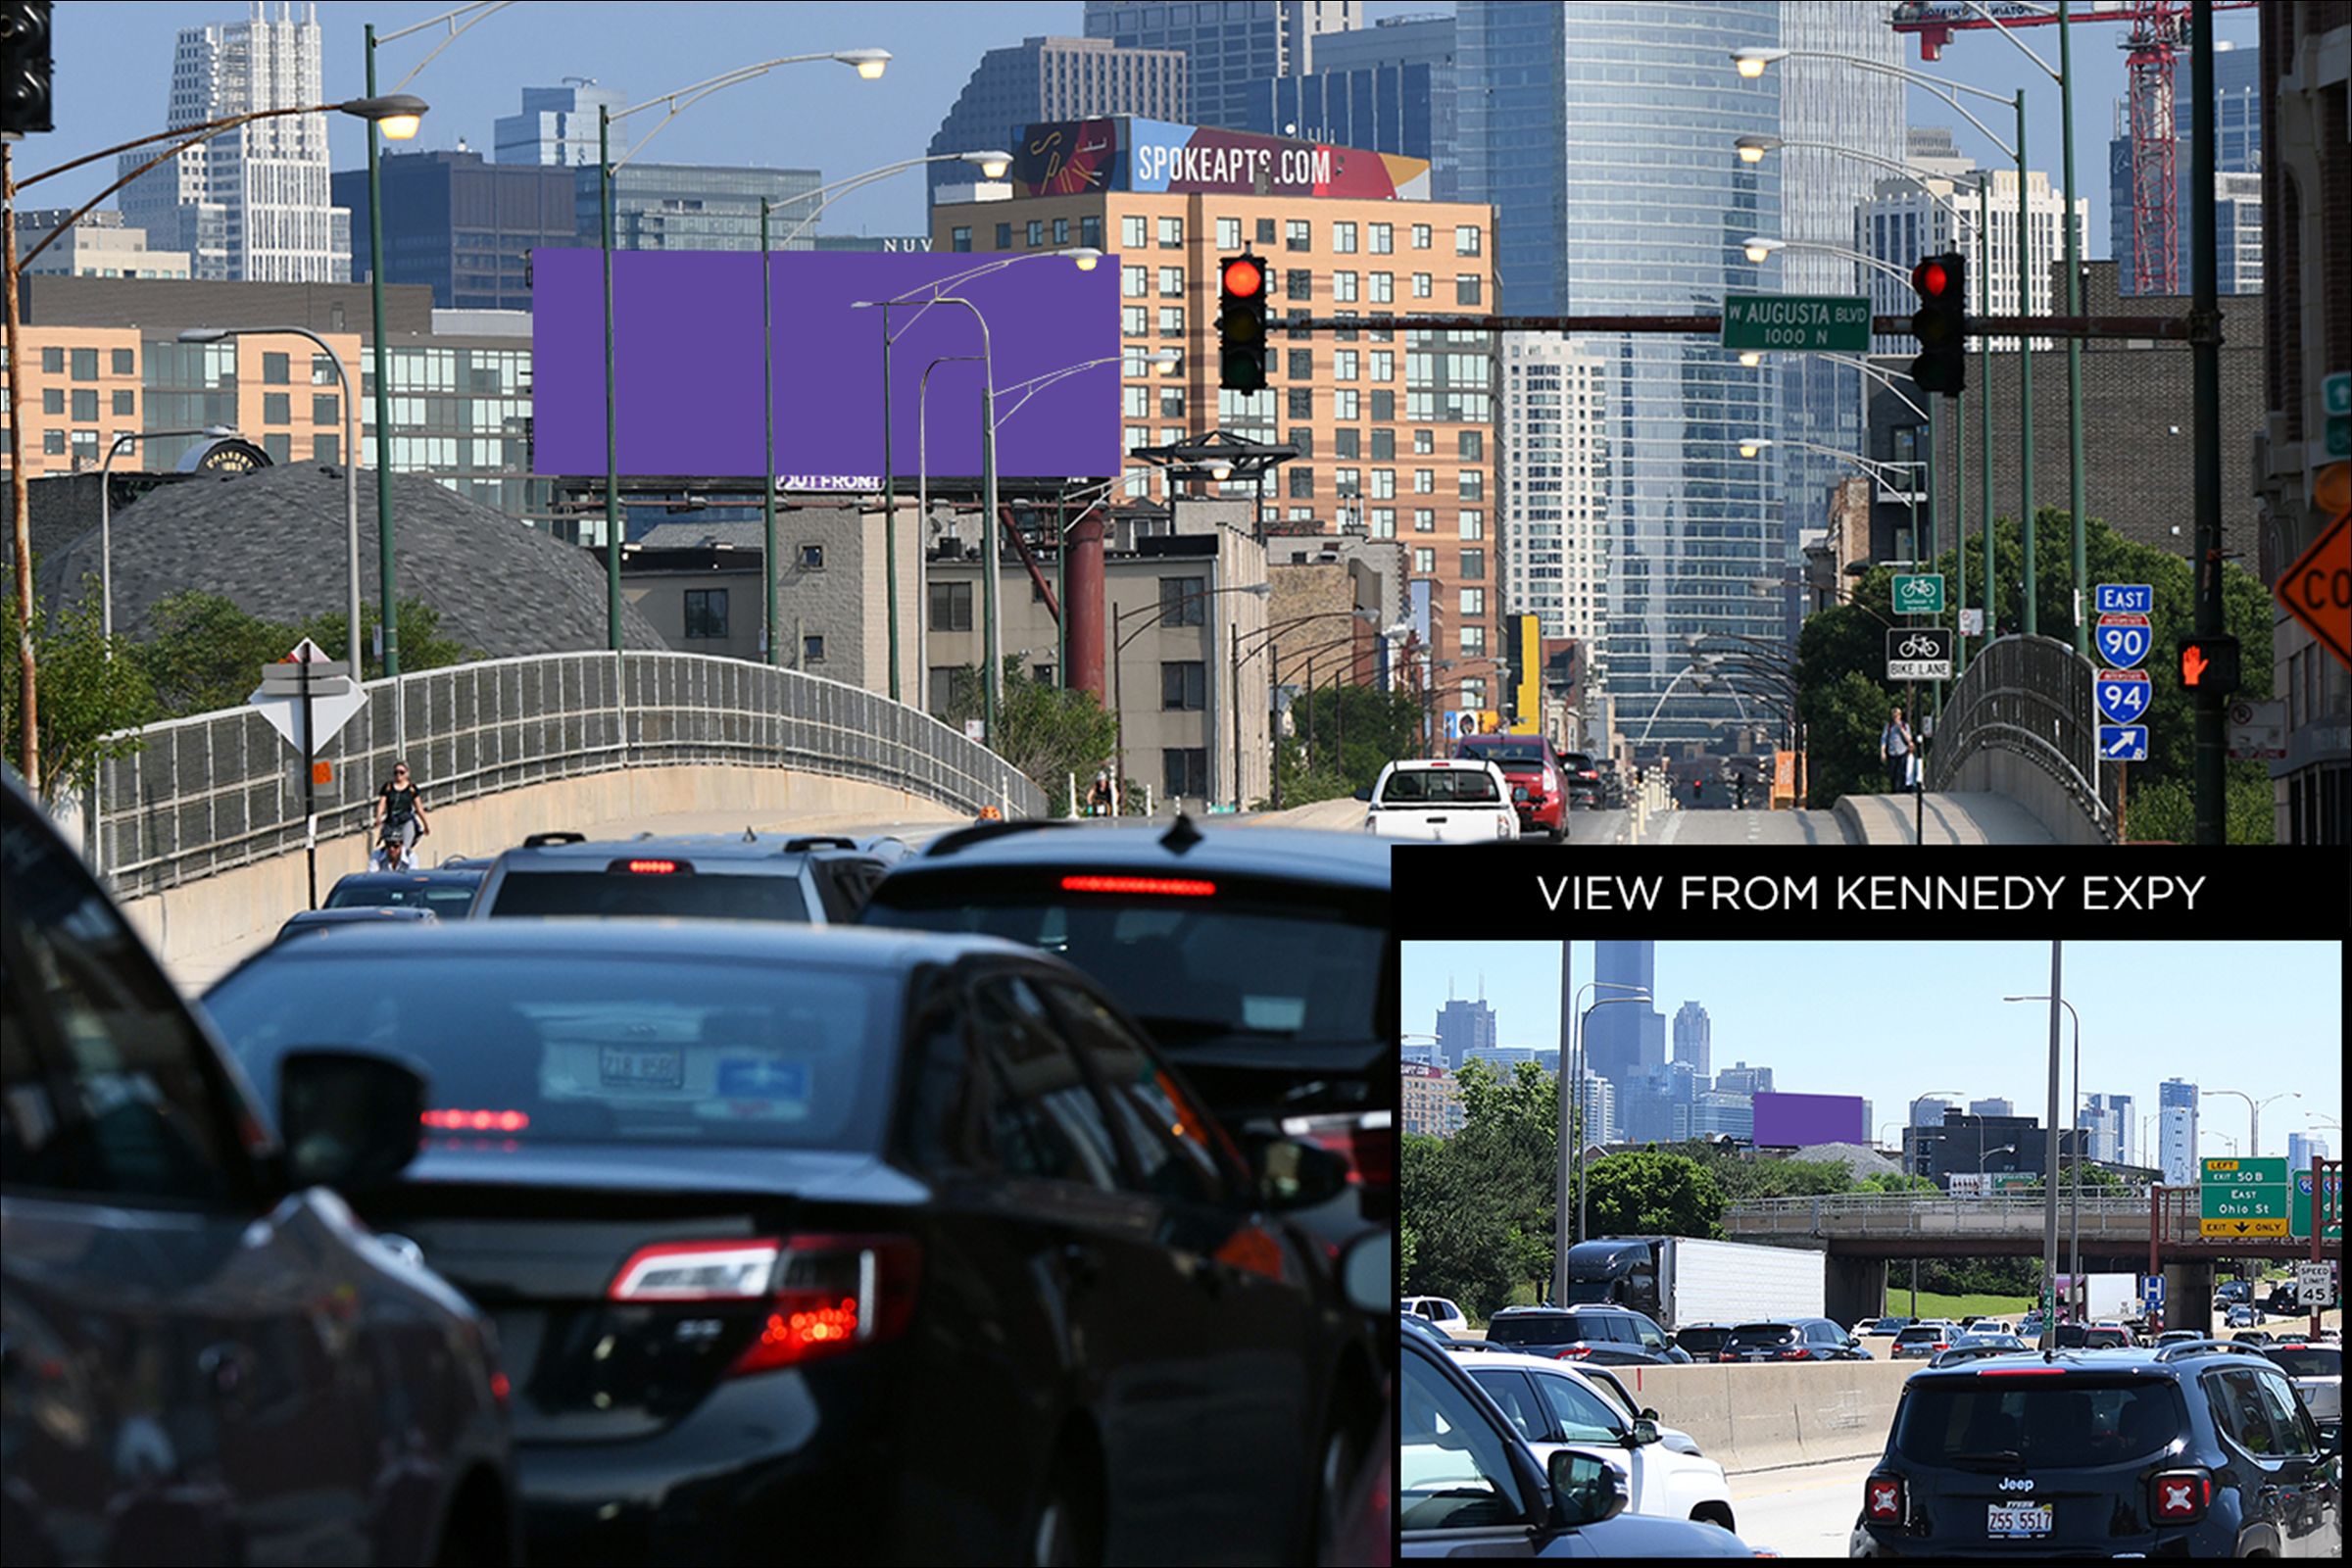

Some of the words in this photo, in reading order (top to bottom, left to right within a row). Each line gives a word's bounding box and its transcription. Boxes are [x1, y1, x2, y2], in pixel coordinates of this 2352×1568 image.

[1139, 145, 1330, 184] SPOKEAPTS.COM
[1729, 305, 1742, 319] W
[1745, 302, 1831, 325] AUGUSTA
[1835, 307, 1867, 322] BLVD
[1765, 328, 1806, 344] 1000
[1816, 329, 1828, 344] N
[2104, 589, 2144, 608] EAST
[2105, 630, 2142, 656] 90
[1890, 662, 1915, 675] BIKE
[1918, 662, 1948, 675] LANE
[2105, 685, 2142, 711] 94
[2211, 1161, 2234, 1170] LEFT
[2230, 1190, 2257, 1200] EAST
[2219, 1203, 2249, 1214] Ohio
[2255, 1203, 2270, 1214] St
[2303, 1288, 2326, 1301] 45
[1999, 1477, 2034, 1493] Jeep
[1989, 1512, 2013, 1531] Z55
[2020, 1512, 2051, 1531] 5517
